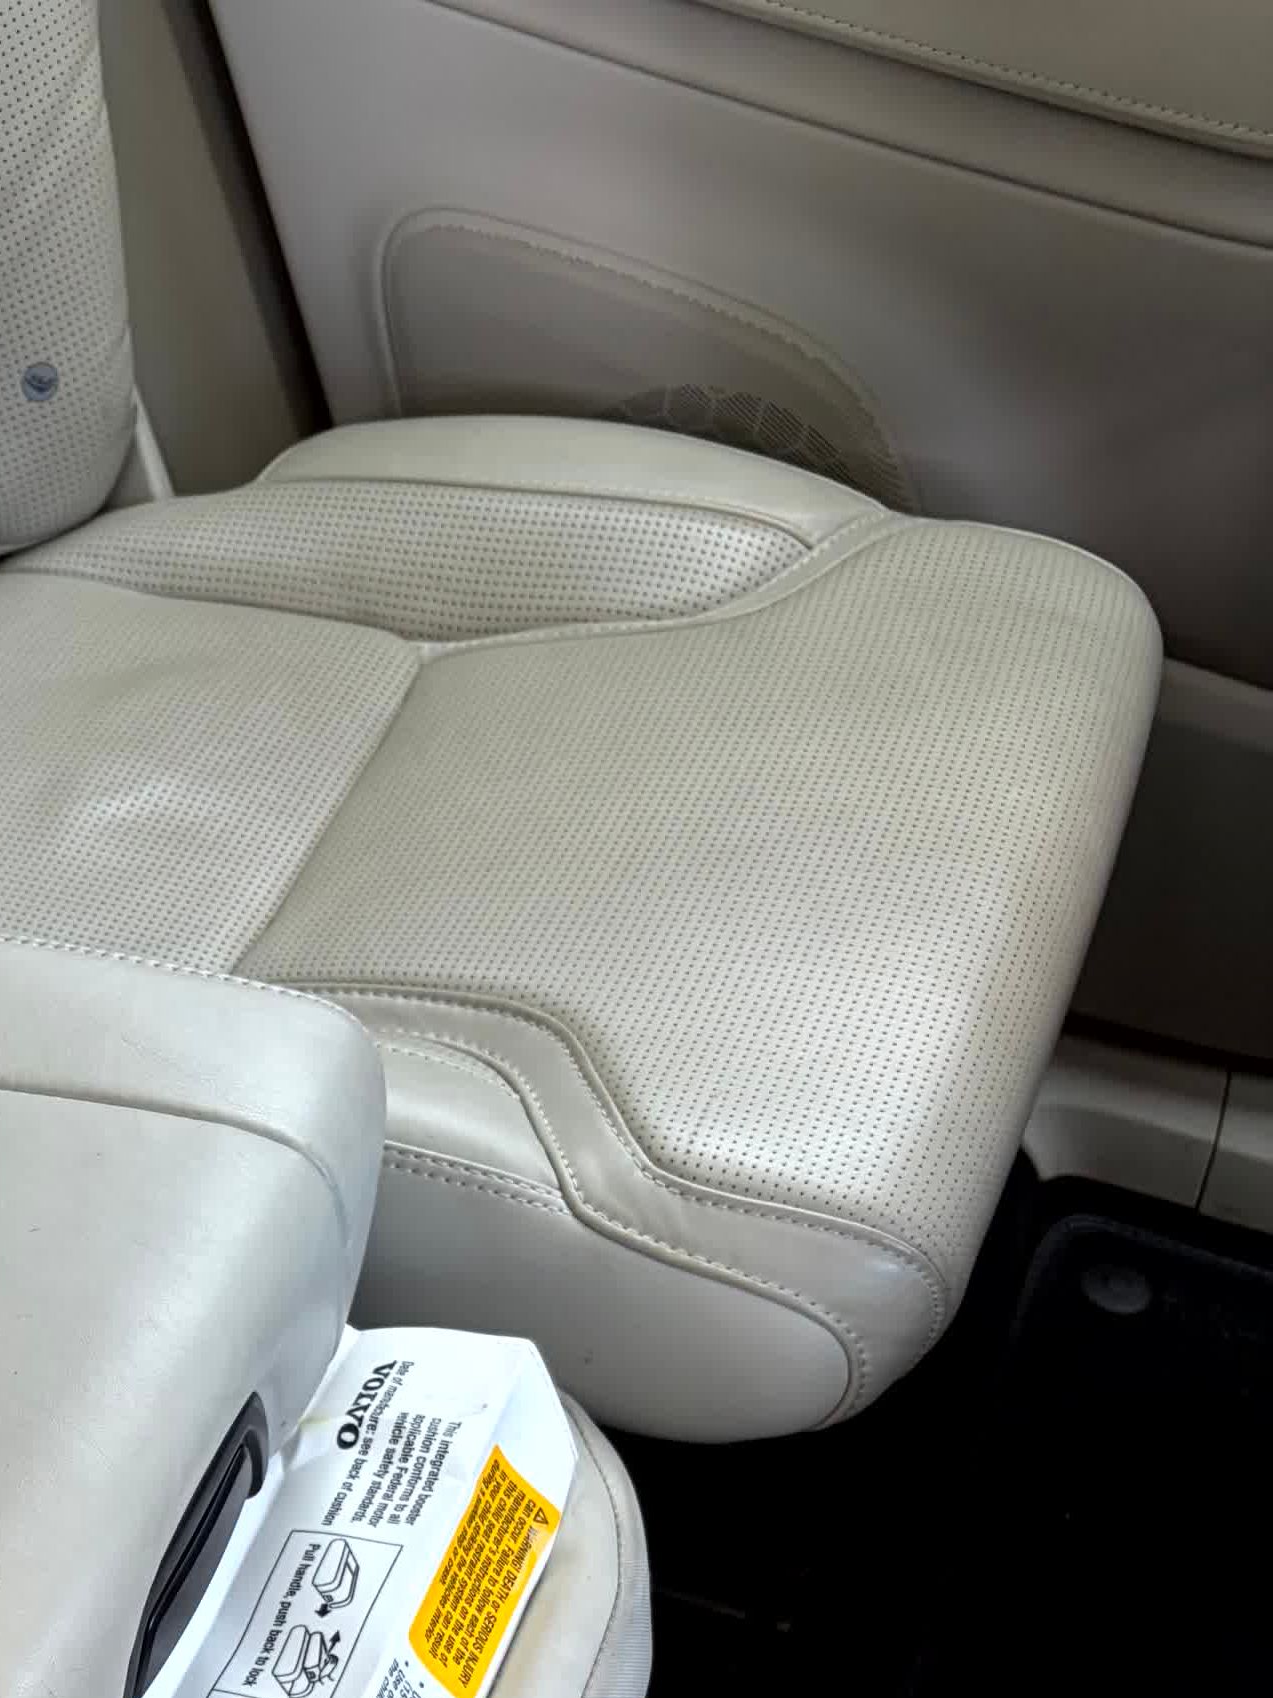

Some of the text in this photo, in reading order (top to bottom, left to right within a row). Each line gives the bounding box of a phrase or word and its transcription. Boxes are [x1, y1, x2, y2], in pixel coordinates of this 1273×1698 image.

[337, 1360, 397, 1450] VOLVO
[357, 1436, 374, 1456] see
[372, 1447, 397, 1479] safety
[346, 1457, 368, 1480] back
[367, 1414, 425, 1528] applicable Federal motor
[386, 1417, 442, 1525] cushion conforms to all
[421, 1439, 452, 1492] integrated
[340, 1481, 354, 1492] of
[350, 1480, 382, 1523] standards.
[320, 1491, 347, 1526] cushion
[404, 1493, 432, 1526] booster
[241, 1542, 322, 1687] Pull handle, push back to lock
[387, 1657, 400, 1678] the
[392, 1668, 406, 1691] Use
